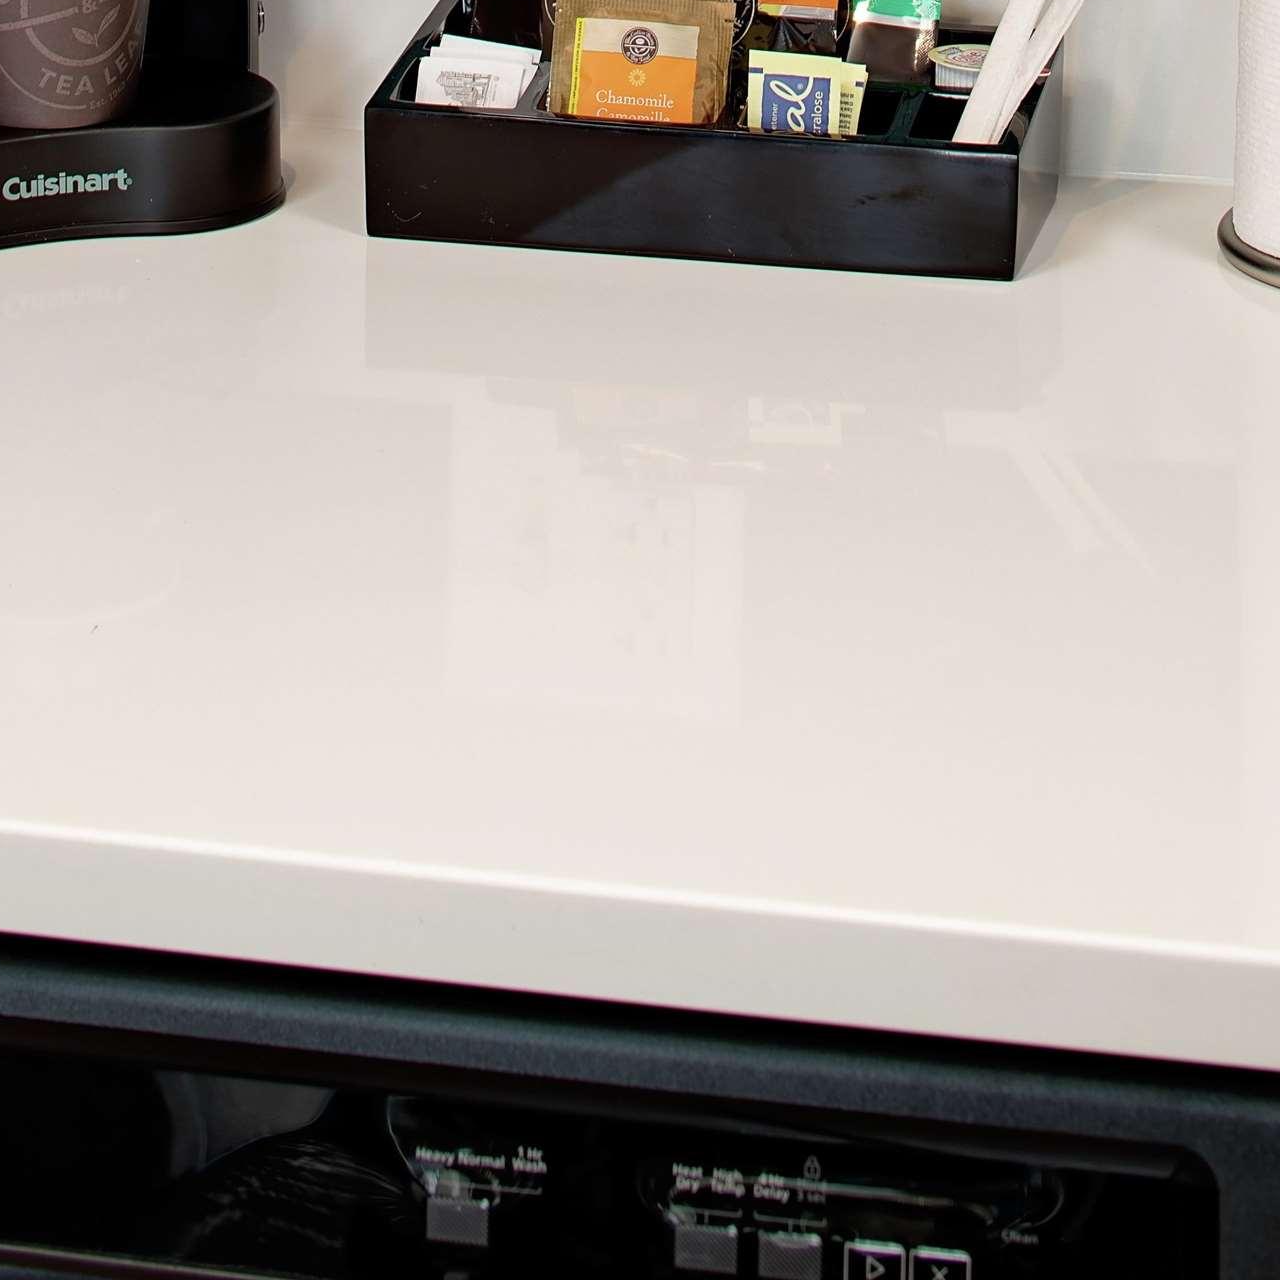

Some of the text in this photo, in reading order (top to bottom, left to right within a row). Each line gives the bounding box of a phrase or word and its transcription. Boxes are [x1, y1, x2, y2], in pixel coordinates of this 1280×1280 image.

[38, 67, 94, 96] TEA
[595, 88, 674, 109] Chamomile
[811, 91, 824, 133] ralose
[771, 103, 780, 130] etener
[2, 168, 129, 201] Cuisinart
[416, 1146, 506, 1170] Heavy Normal
[512, 1156, 548, 1174] Wash
